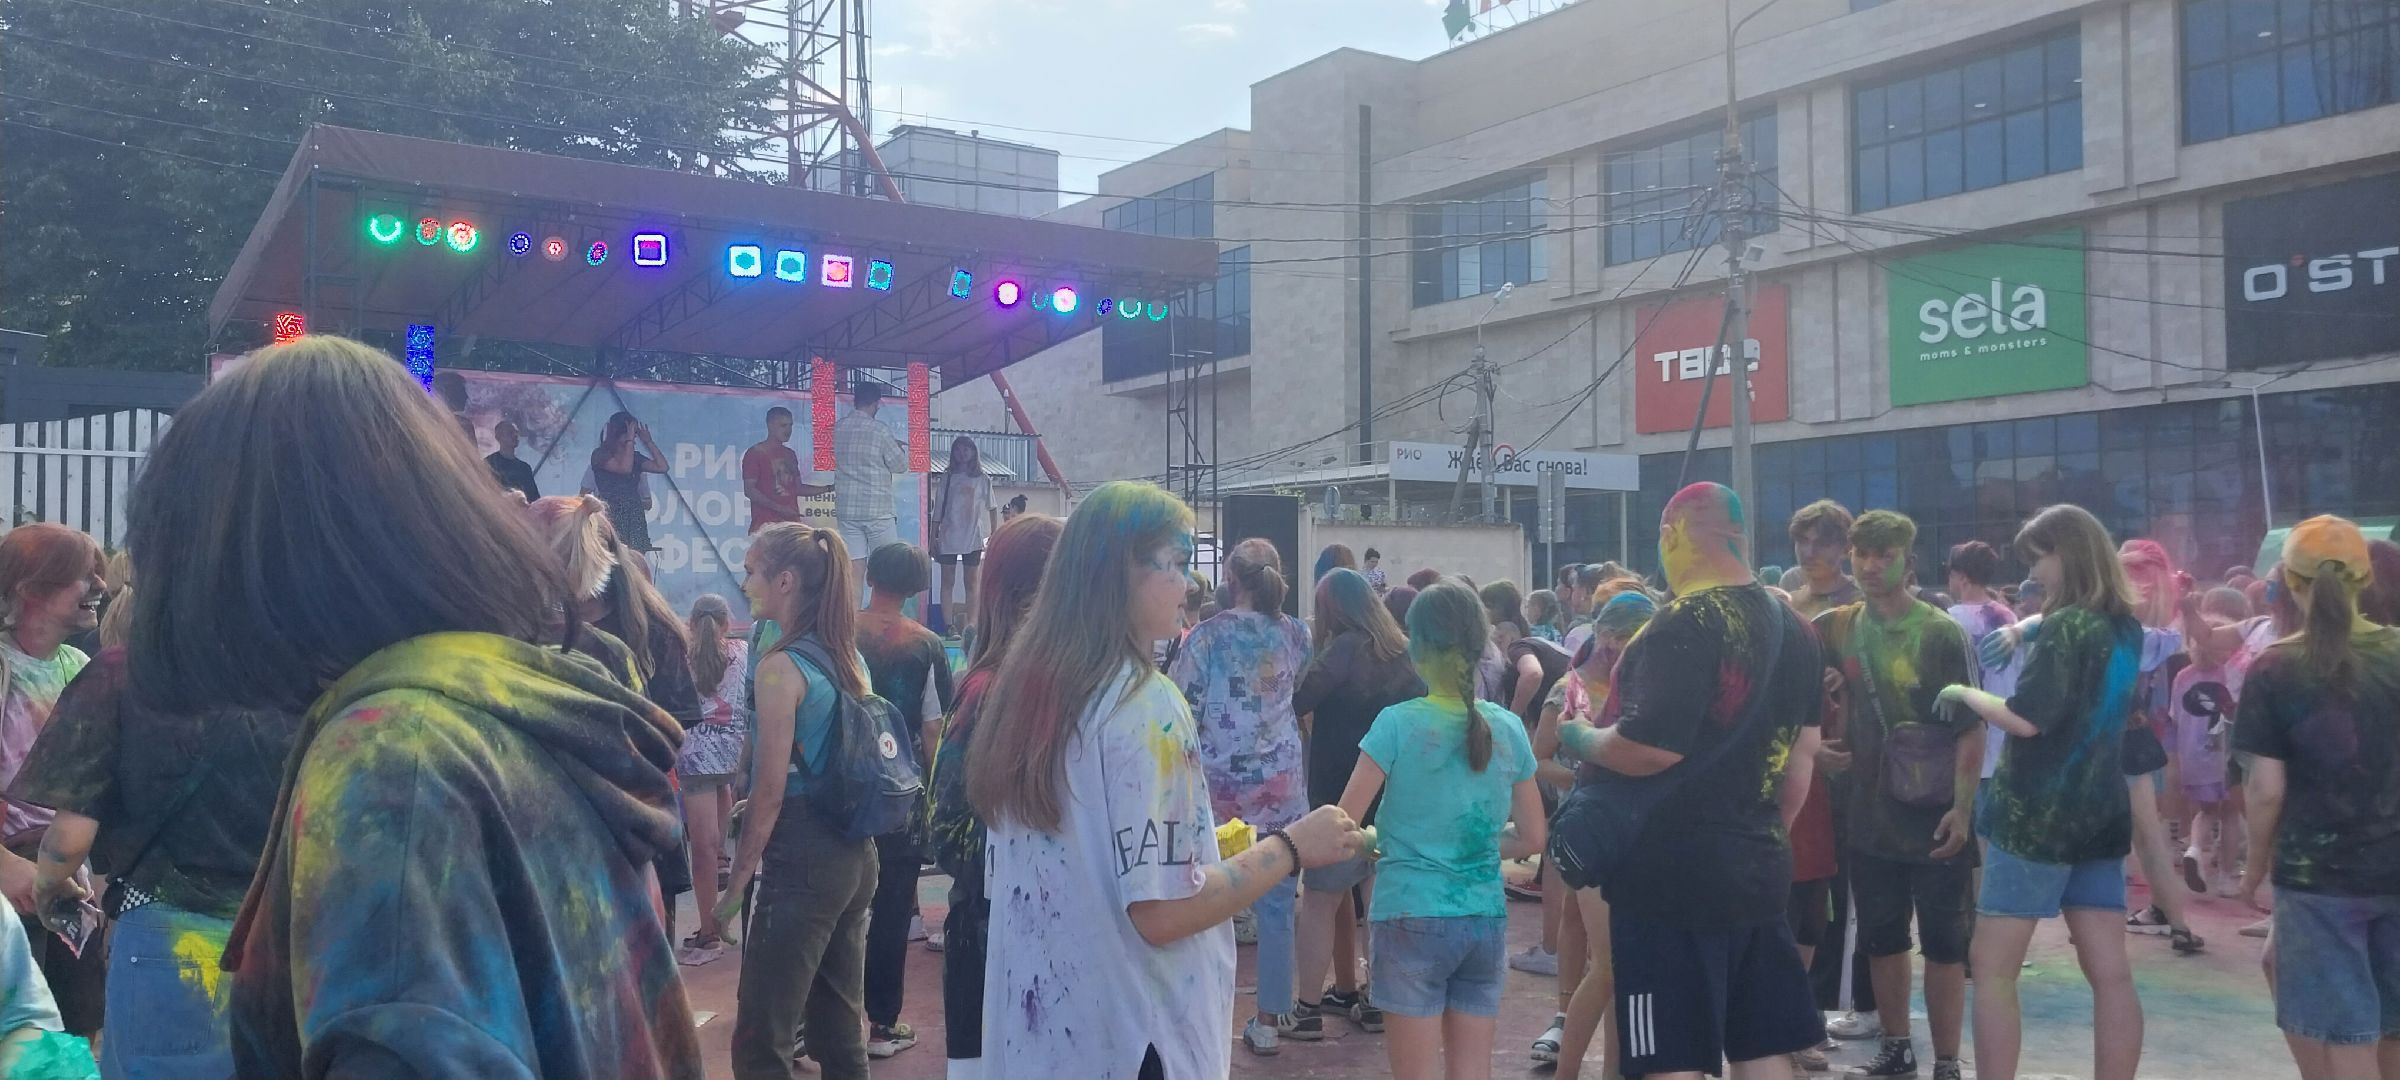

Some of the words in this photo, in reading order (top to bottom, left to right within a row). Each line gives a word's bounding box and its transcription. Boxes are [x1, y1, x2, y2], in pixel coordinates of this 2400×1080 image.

[1919, 277, 2046, 344] sela
[1654, 344, 1759, 382] ТВО
[1920, 349, 1957, 361] moms
[1964, 346, 1972, 355] &
[1978, 337, 2047, 353] monsters
[675, 443, 748, 480] РИ
[1397, 448, 1422, 461] РИО
[1537, 459, 1587, 476] снова!
